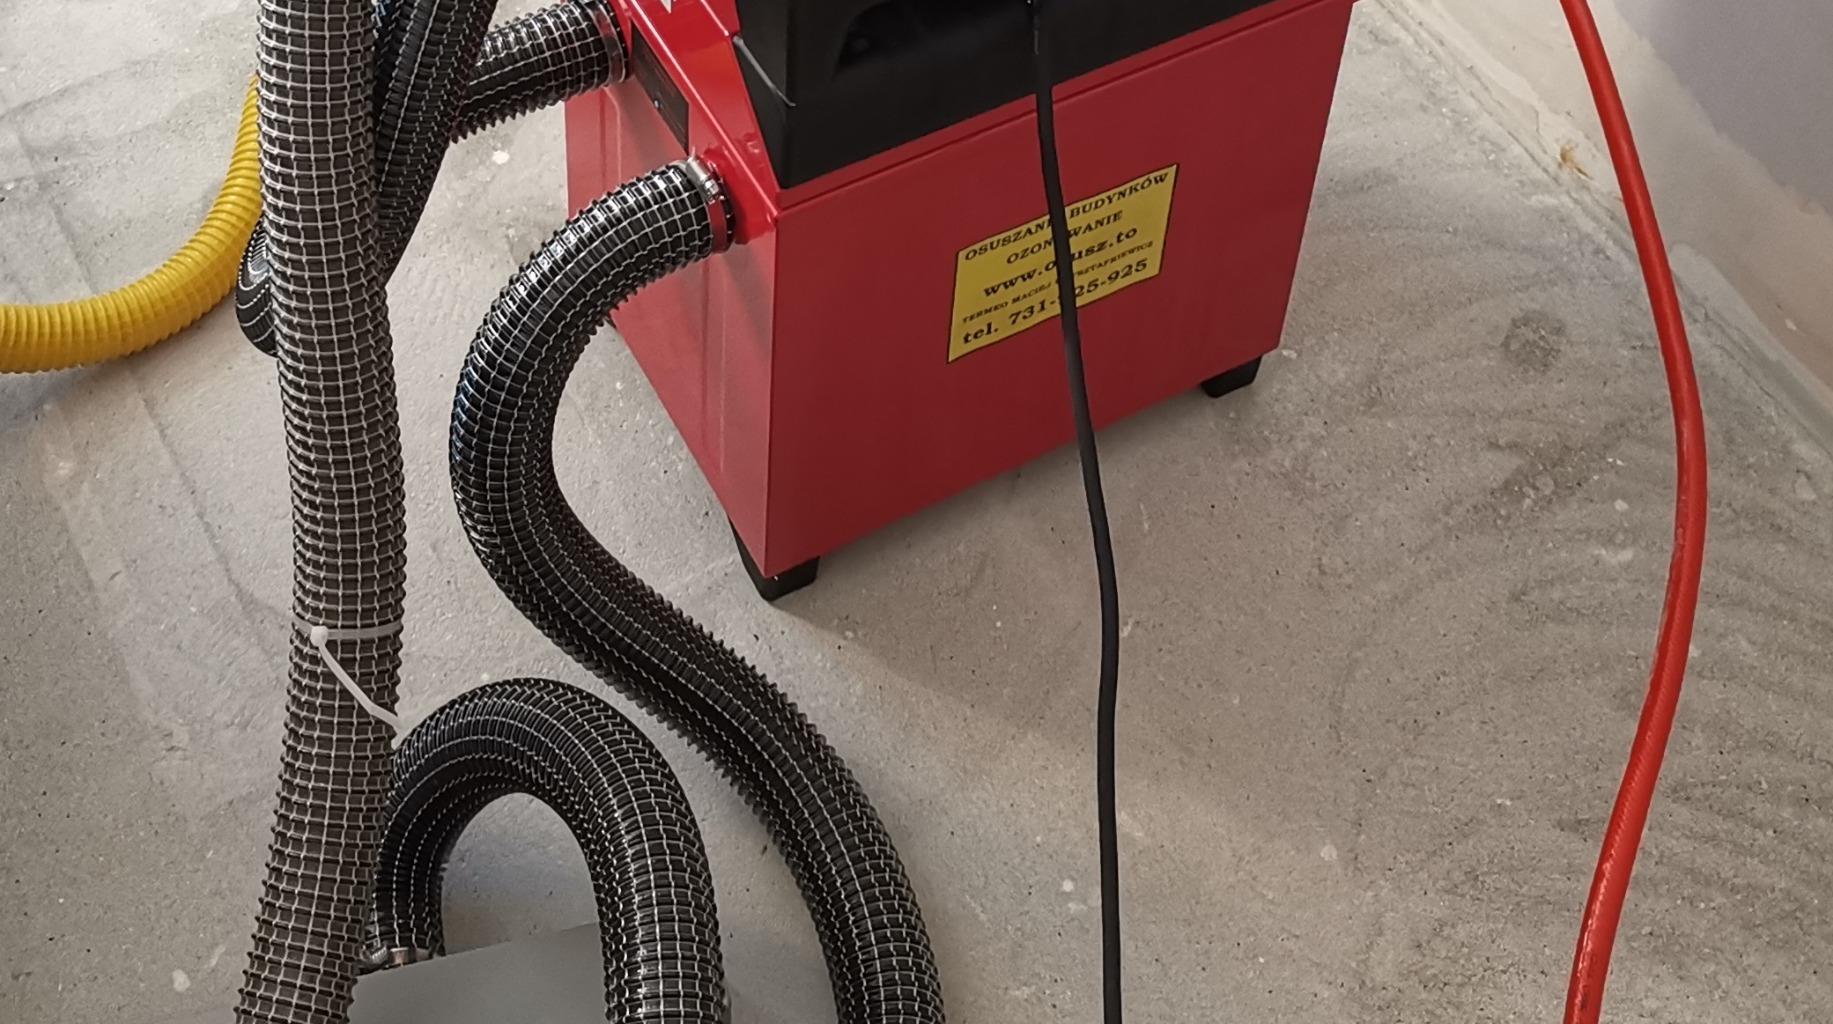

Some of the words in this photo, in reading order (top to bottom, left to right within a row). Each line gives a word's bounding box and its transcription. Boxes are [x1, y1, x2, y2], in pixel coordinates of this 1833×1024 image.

[964, 218, 1052, 261] OSUSZANI
[1069, 171, 1169, 219] BUDYNKÓW
[1006, 210, 1123, 264] OZONWANIE
[983, 227, 1138, 297] www.ousz.to
[963, 322, 999, 345] tel.
[1007, 258, 1149, 325] 731-25-925
